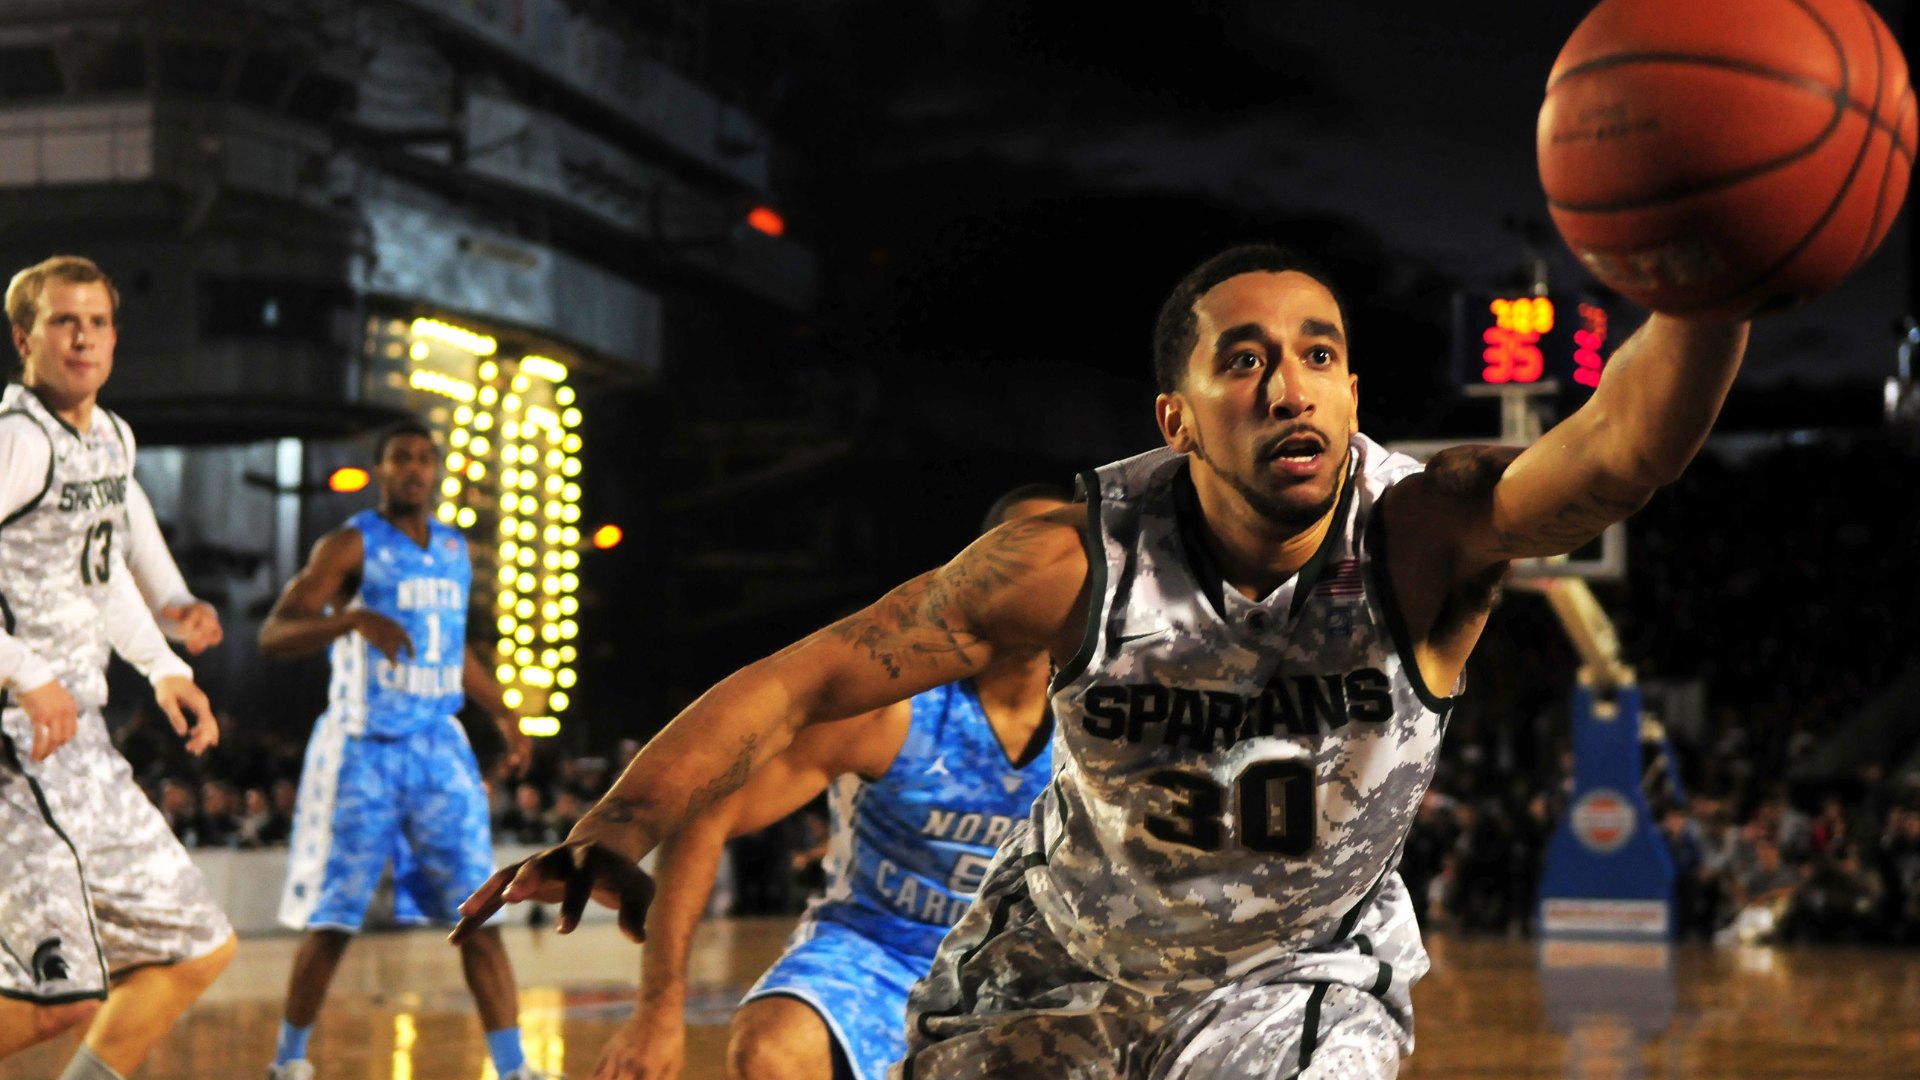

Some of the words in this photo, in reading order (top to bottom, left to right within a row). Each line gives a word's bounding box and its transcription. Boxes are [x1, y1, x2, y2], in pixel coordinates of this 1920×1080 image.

[81, 520, 113, 585] 13
[425, 612, 441, 663] 1
[921, 809, 1029, 848] NOR
[1144, 759, 1317, 855] 30
